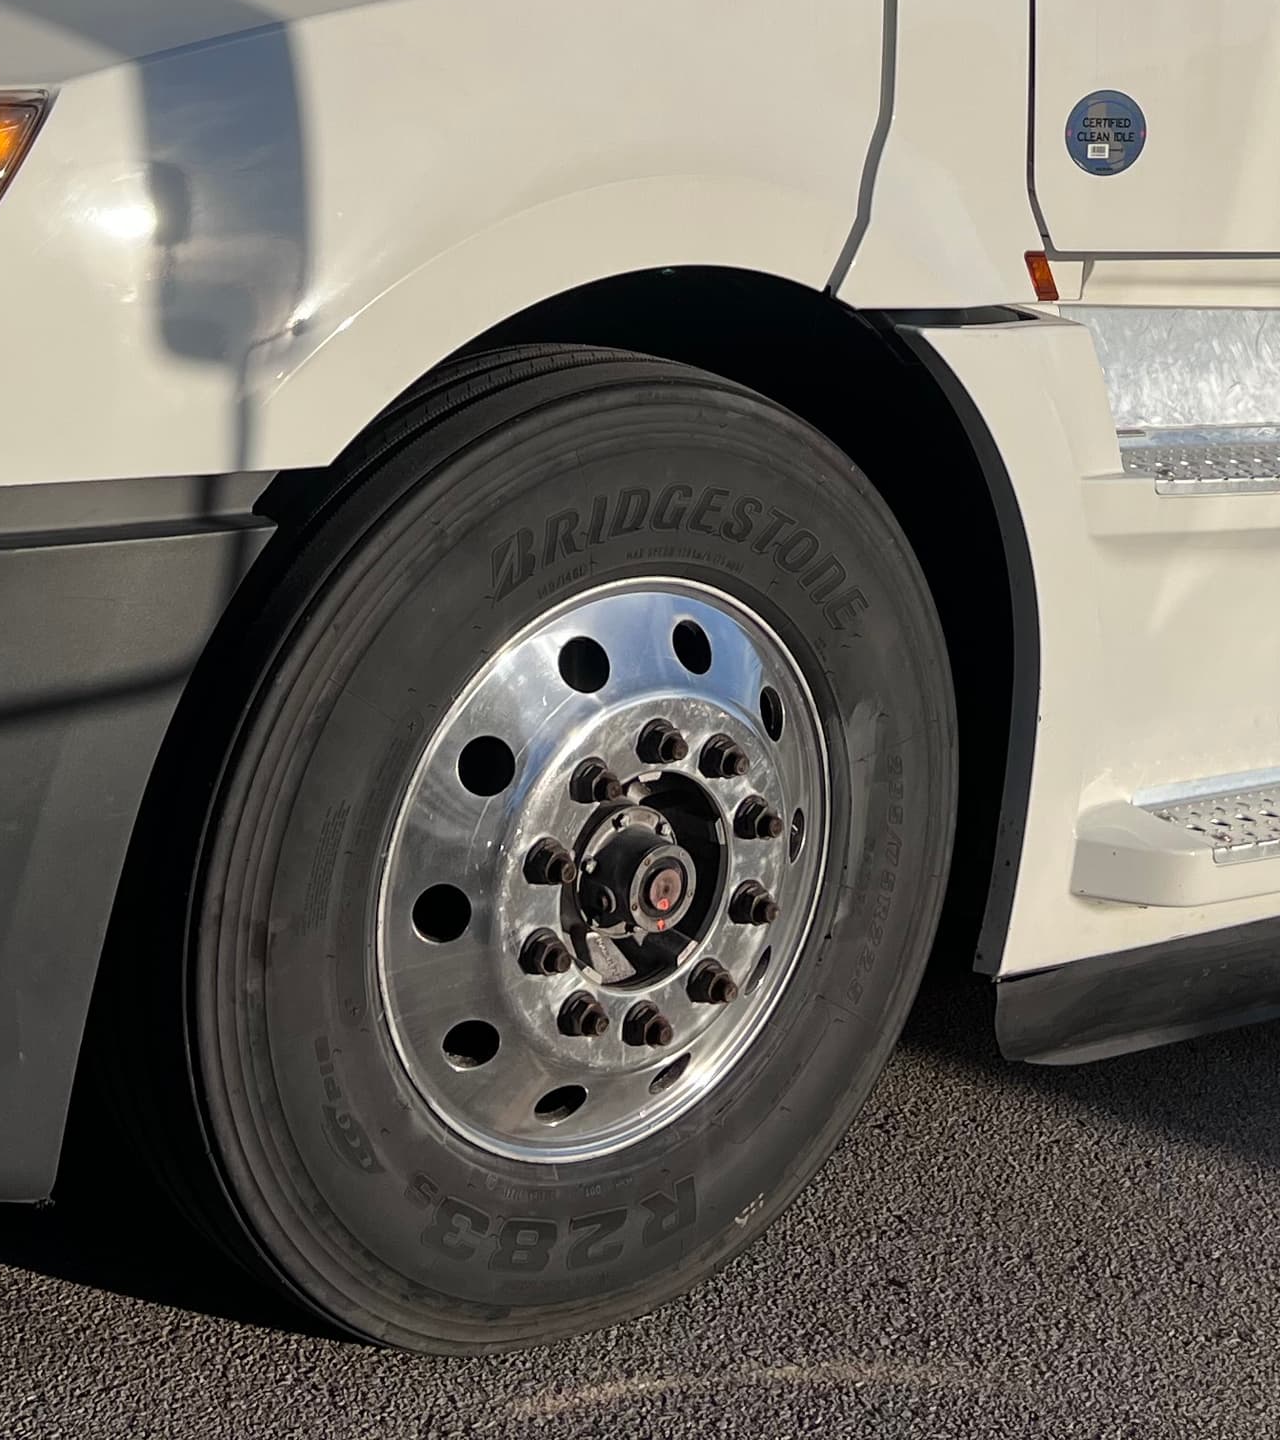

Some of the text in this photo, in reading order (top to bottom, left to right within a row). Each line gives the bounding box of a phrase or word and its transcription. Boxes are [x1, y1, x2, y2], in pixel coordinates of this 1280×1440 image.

[1082, 117, 1132, 128] CERTIFIED
[1077, 131, 1135, 142] CLEAN IDLE
[487, 481, 871, 632] BRIDGESTONE
